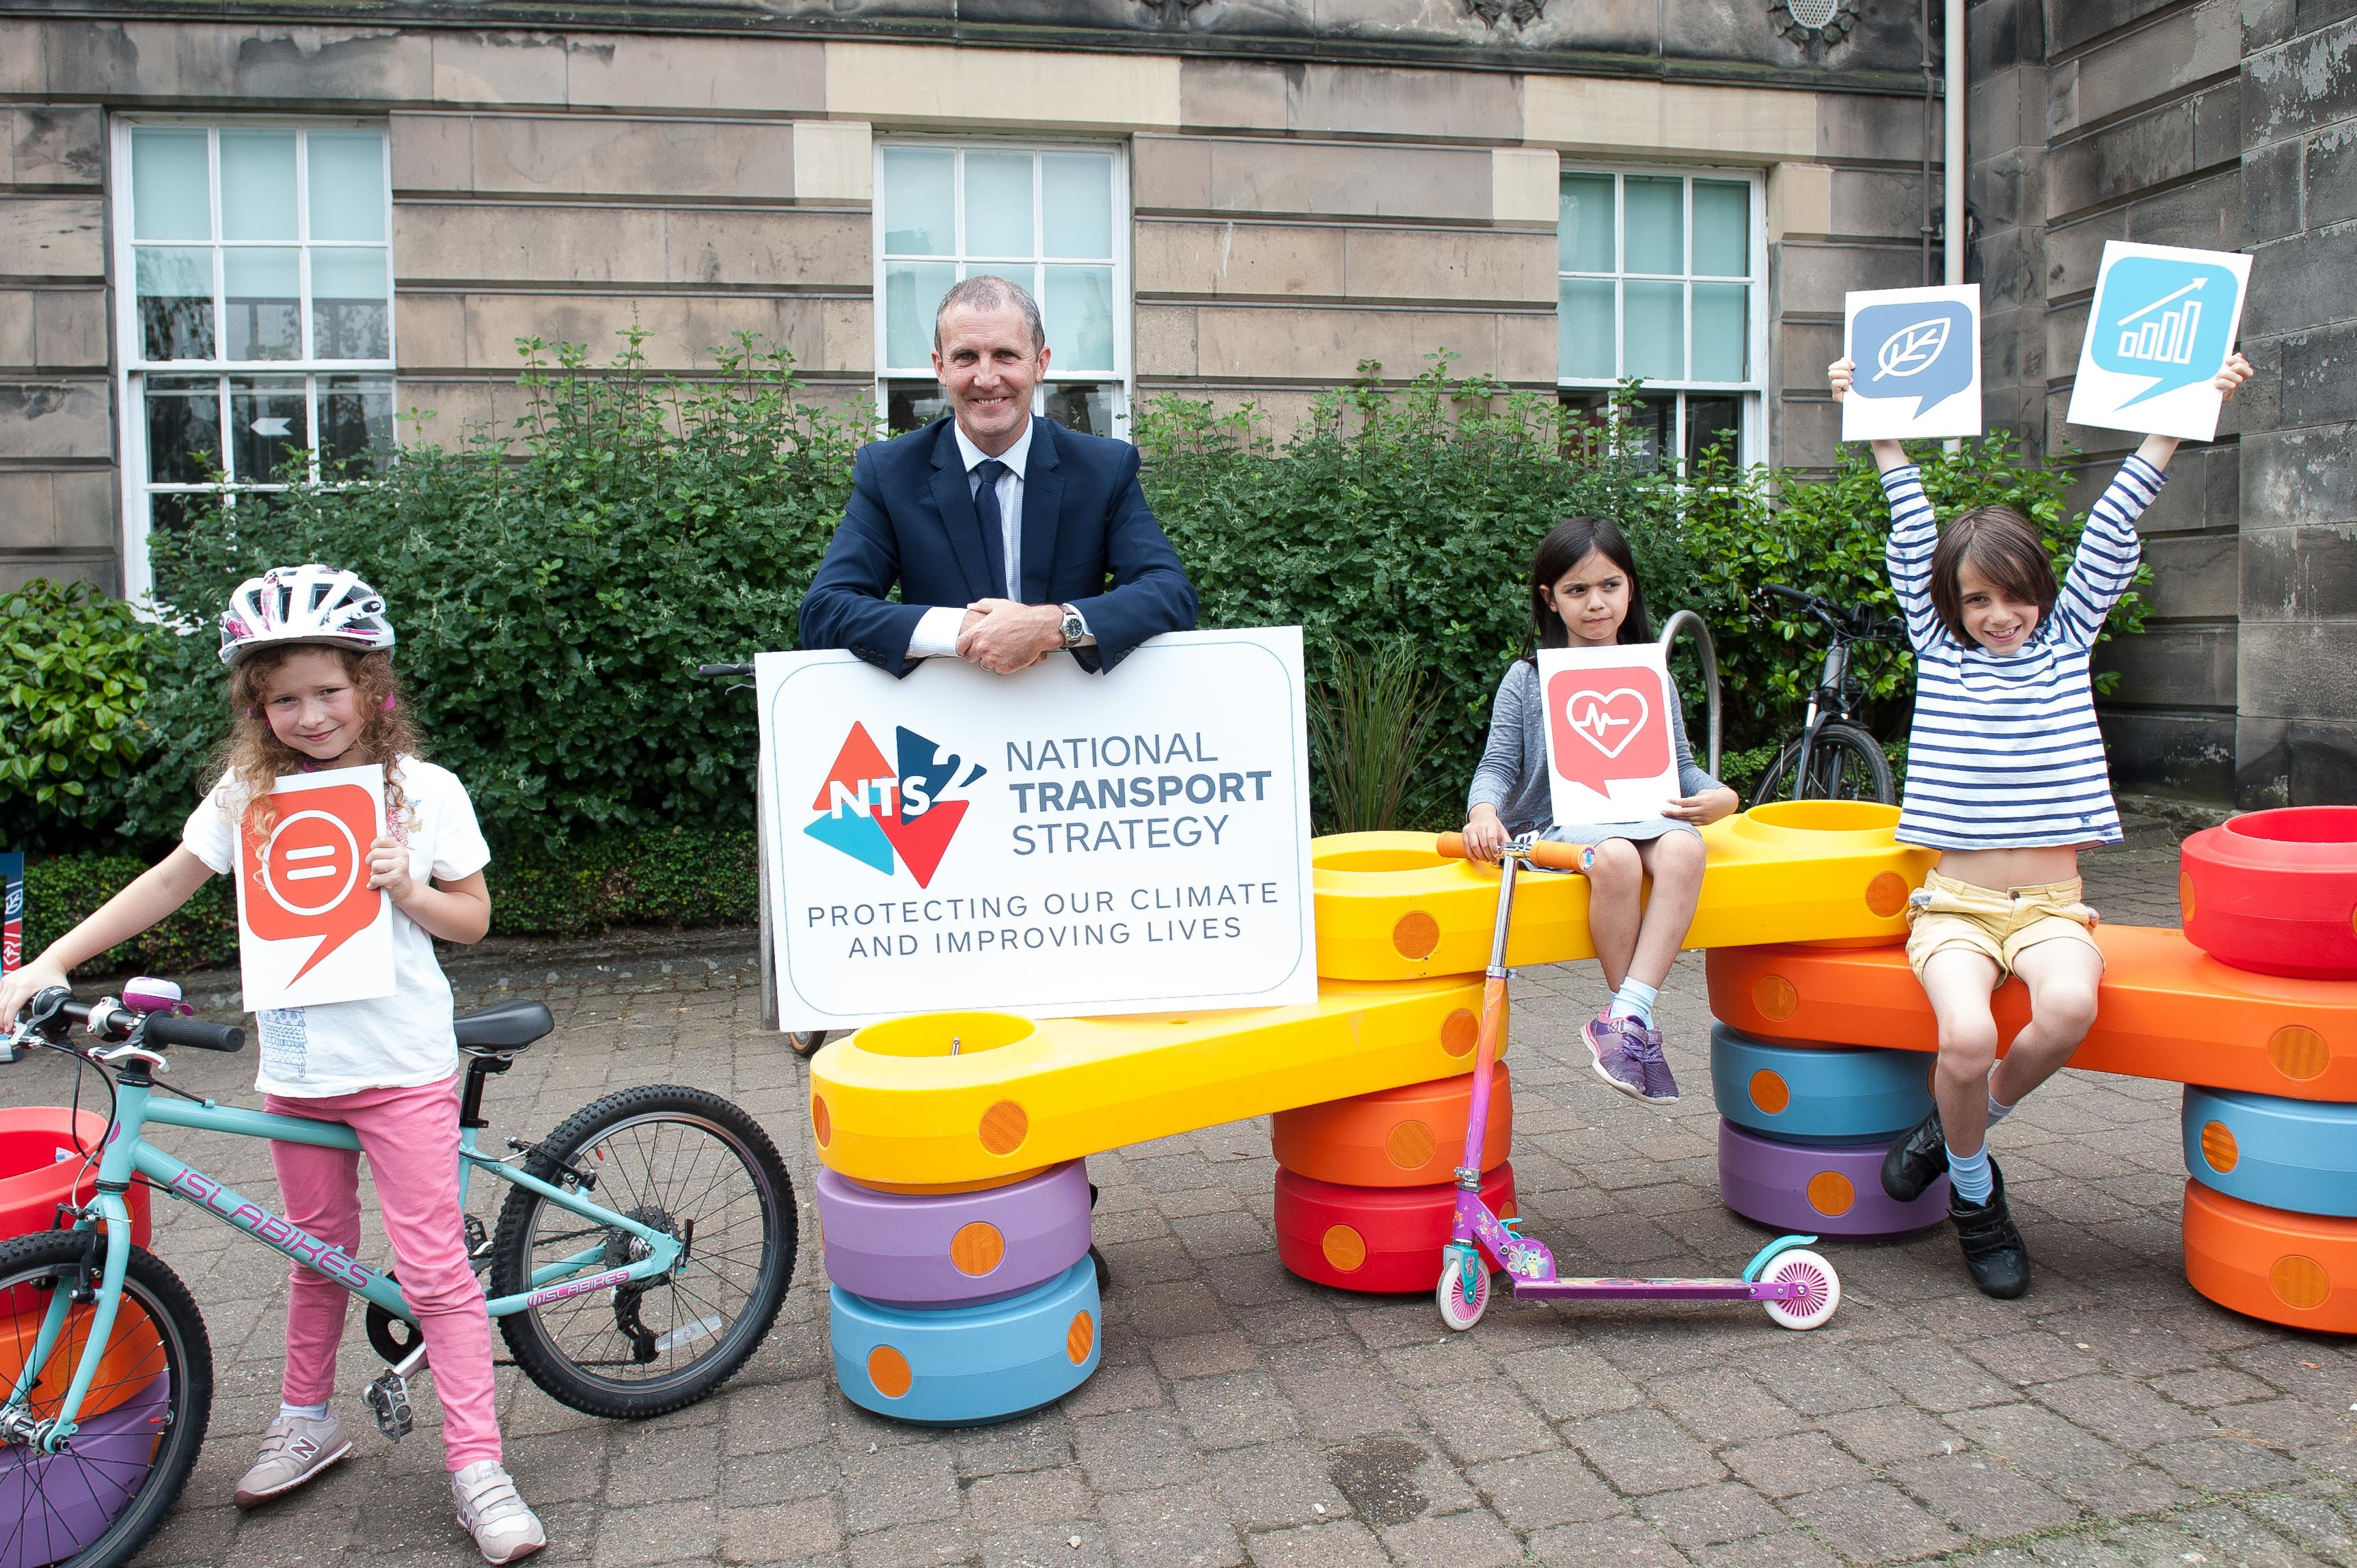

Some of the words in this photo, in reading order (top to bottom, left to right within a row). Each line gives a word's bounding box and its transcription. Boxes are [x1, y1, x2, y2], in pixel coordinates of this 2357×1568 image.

[1007, 732, 1218, 772] NATIONAL
[1009, 770, 1272, 814] TRANSPORT
[1013, 814, 1229, 855] STRATEGY
[808, 895, 1027, 928] PROTECTING
[1044, 891, 1114, 915] OUR
[1131, 882, 1278, 910] CLIMATE
[848, 935, 918, 959] AND
[936, 922, 1130, 954] IMPROVING
[1147, 916, 1240, 942] LIVES
[169, 1168, 374, 1289] ISLABIKES
[542, 1271, 627, 1303] ISLABIKES
[288, 1435, 320, 1461] N
